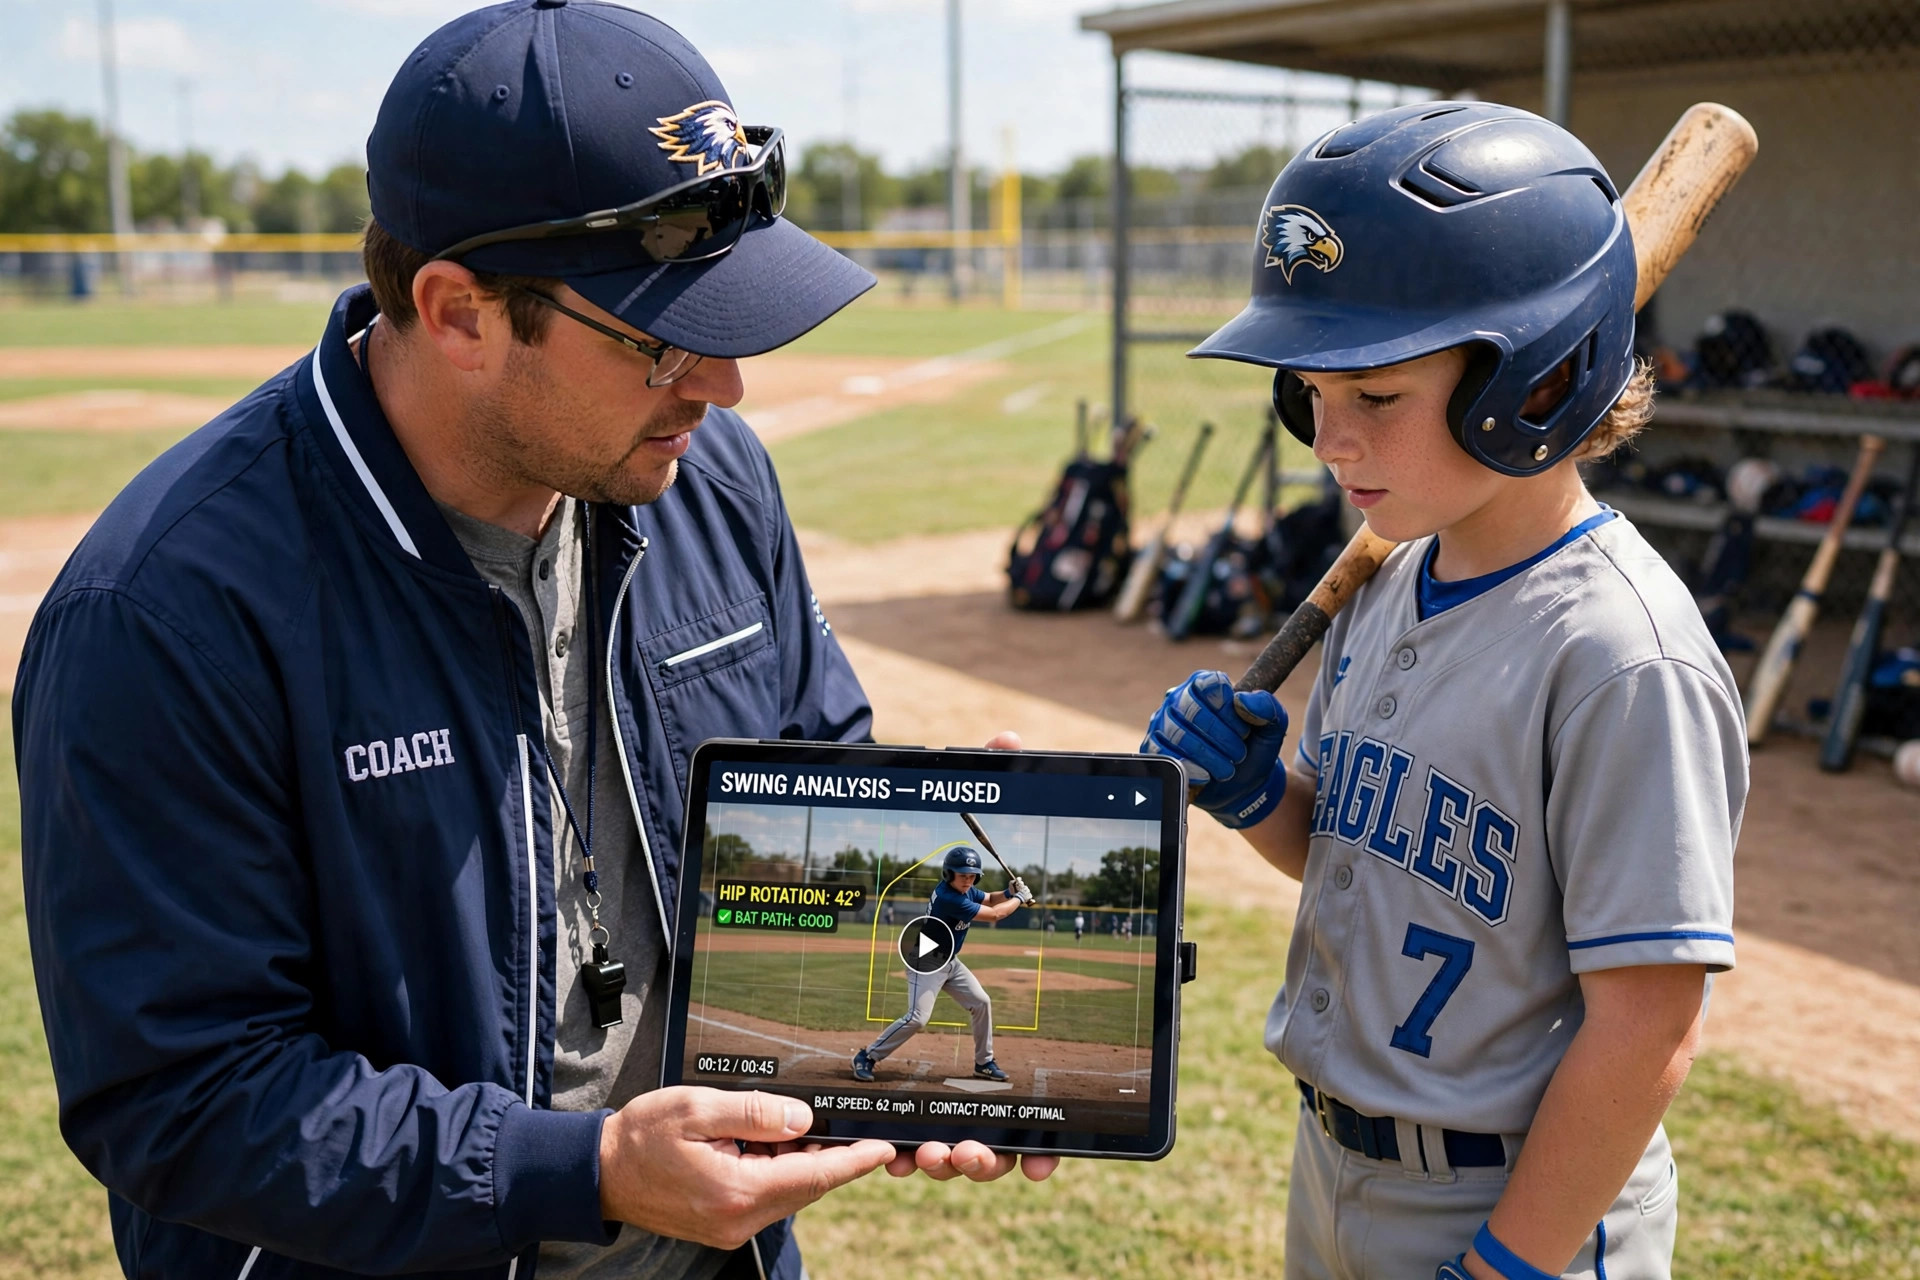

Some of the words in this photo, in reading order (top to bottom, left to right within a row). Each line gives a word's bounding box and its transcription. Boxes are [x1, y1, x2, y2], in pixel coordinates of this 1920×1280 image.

[344, 728, 456, 782] COACH
[720, 771, 788, 795] SWING
[792, 775, 891, 800] ANALYSIS
[921, 780, 1001, 804] PAUSED
[719, 884, 746, 901] HIP
[750, 885, 830, 906] ROTATION:
[834, 890, 861, 906] 42°
[735, 911, 758, 925] BAT
[761, 911, 796, 927] PATH:
[798, 913, 834, 928] GOOD
[1389, 922, 1476, 1059] 7
[698, 1057, 730, 1072] 00:12
[741, 1059, 775, 1075] 00:45
[814, 1095, 835, 1109] BAT
[836, 1096, 874, 1111] SPEED:
[875, 1098, 890, 1112] 62
[892, 1099, 915, 1115] mph
[929, 1101, 979, 1116] CONTACT
[980, 1103, 1016, 1118] POINT:
[1017, 1105, 1066, 1121] OPTIMAL
